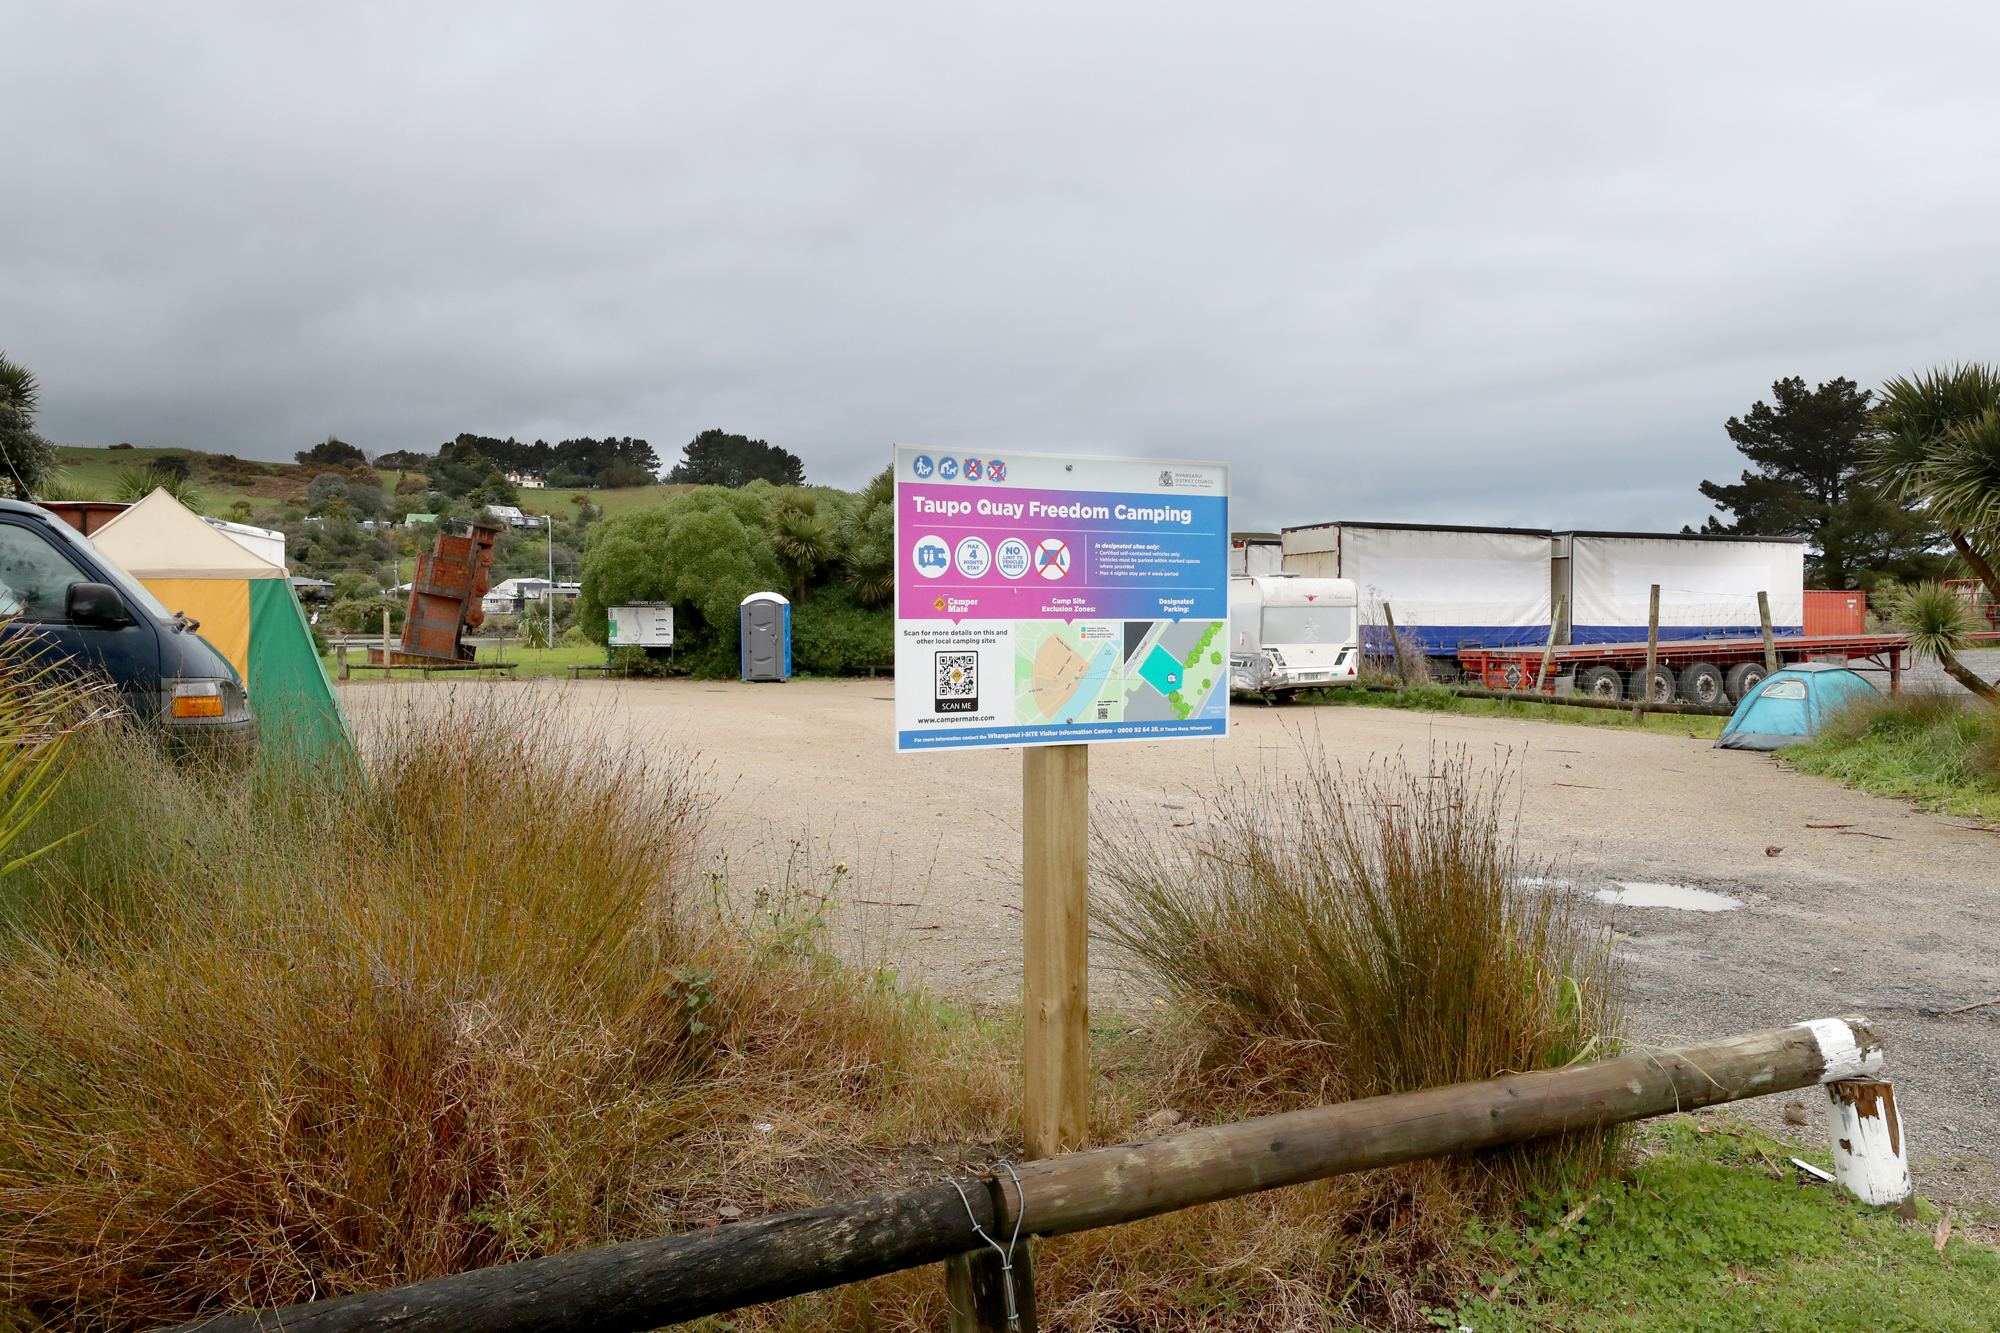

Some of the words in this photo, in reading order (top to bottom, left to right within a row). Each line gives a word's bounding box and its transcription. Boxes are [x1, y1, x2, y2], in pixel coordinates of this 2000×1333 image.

[912, 496, 972, 517] Taupo
[977, 499, 1024, 520] Quay
[1030, 501, 1110, 520] Freedom
[1114, 504, 1192, 525] Camping
[969, 550, 978, 559] 4
[1006, 546, 1020, 555] NO
[948, 598, 978, 606] Camper
[918, 716, 995, 724] www.campermate.com
